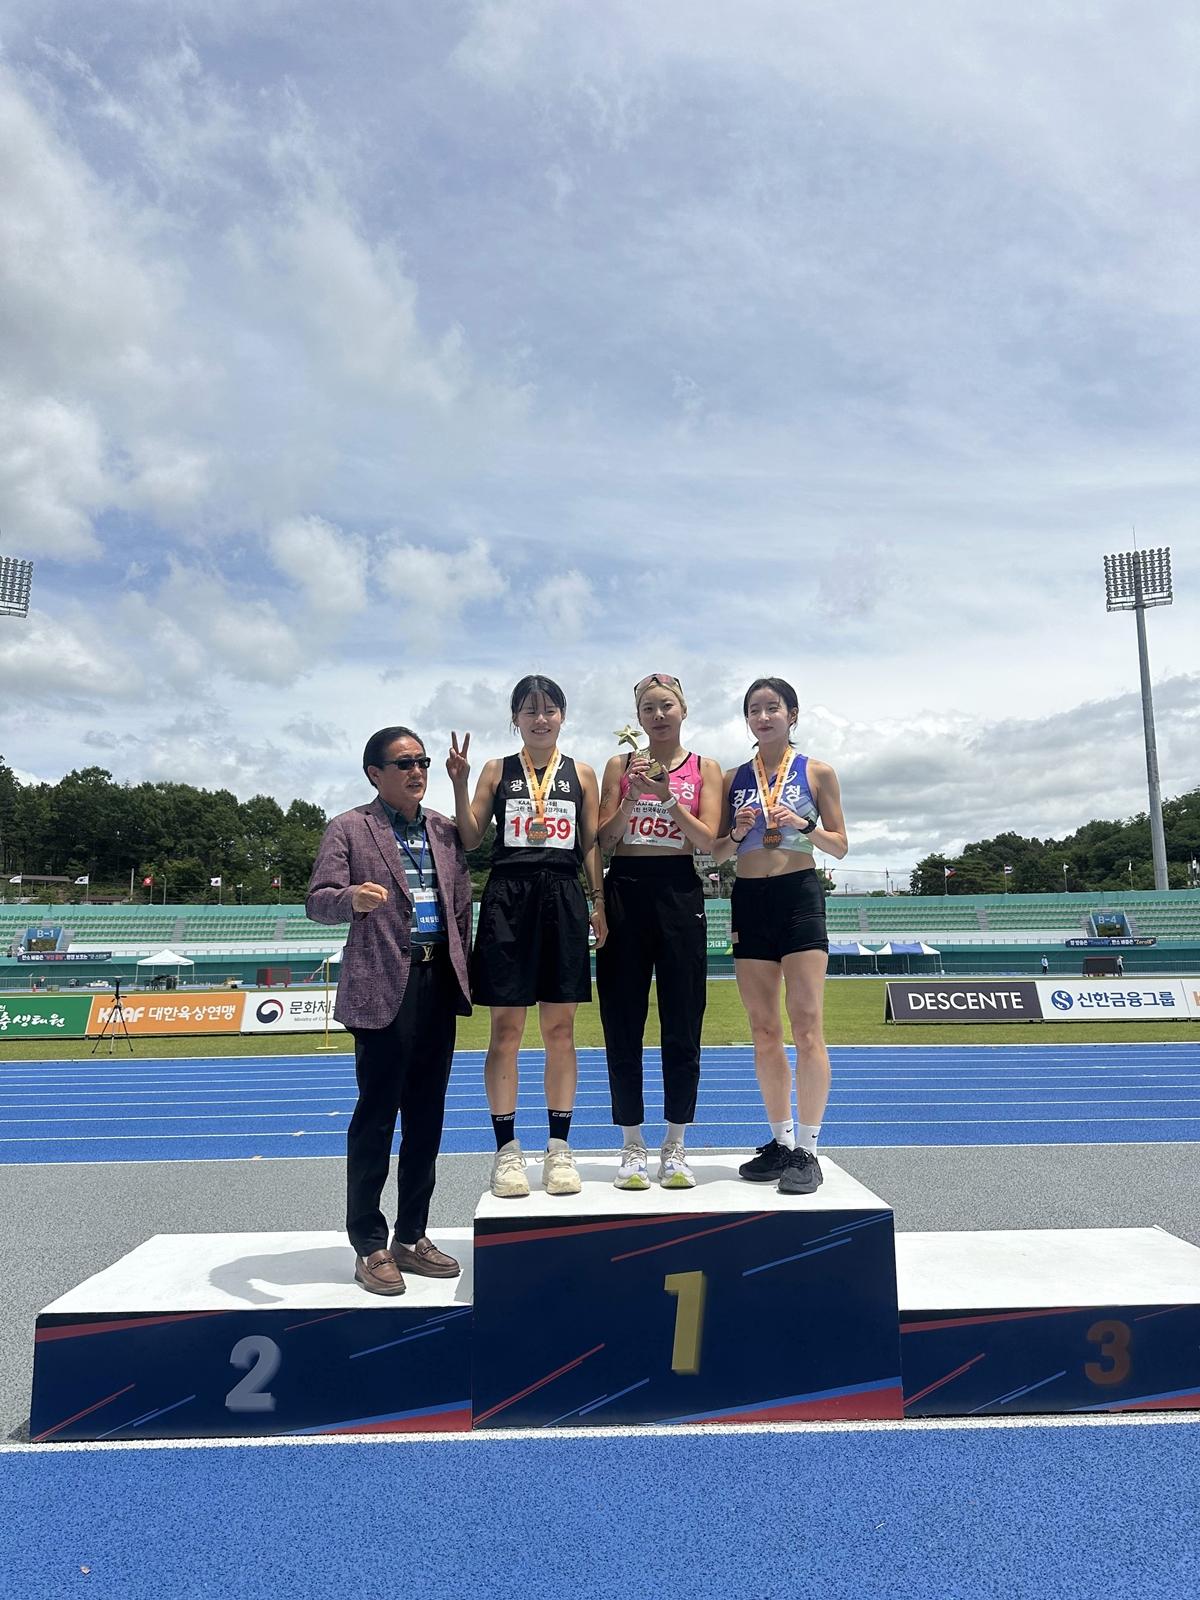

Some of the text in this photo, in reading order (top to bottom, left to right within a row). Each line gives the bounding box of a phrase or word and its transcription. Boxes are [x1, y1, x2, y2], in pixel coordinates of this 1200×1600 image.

[510, 779, 571, 793] 광청
[734, 785, 801, 806] 경기청
[629, 815, 682, 840] 1052
[1098, 915, 1117, 924] B-4
[37, 929, 54, 938] B-1
[289, 1000, 336, 1014] 문화체
[907, 991, 1024, 1010] DESCENTE
[1077, 990, 1176, 1008] 신한금융그룹
[148, 1004, 236, 1022] 대한육상연맹
[664, 1270, 706, 1375] 1
[1084, 1319, 1132, 1386] 3
[225, 1335, 282, 1412] 2
